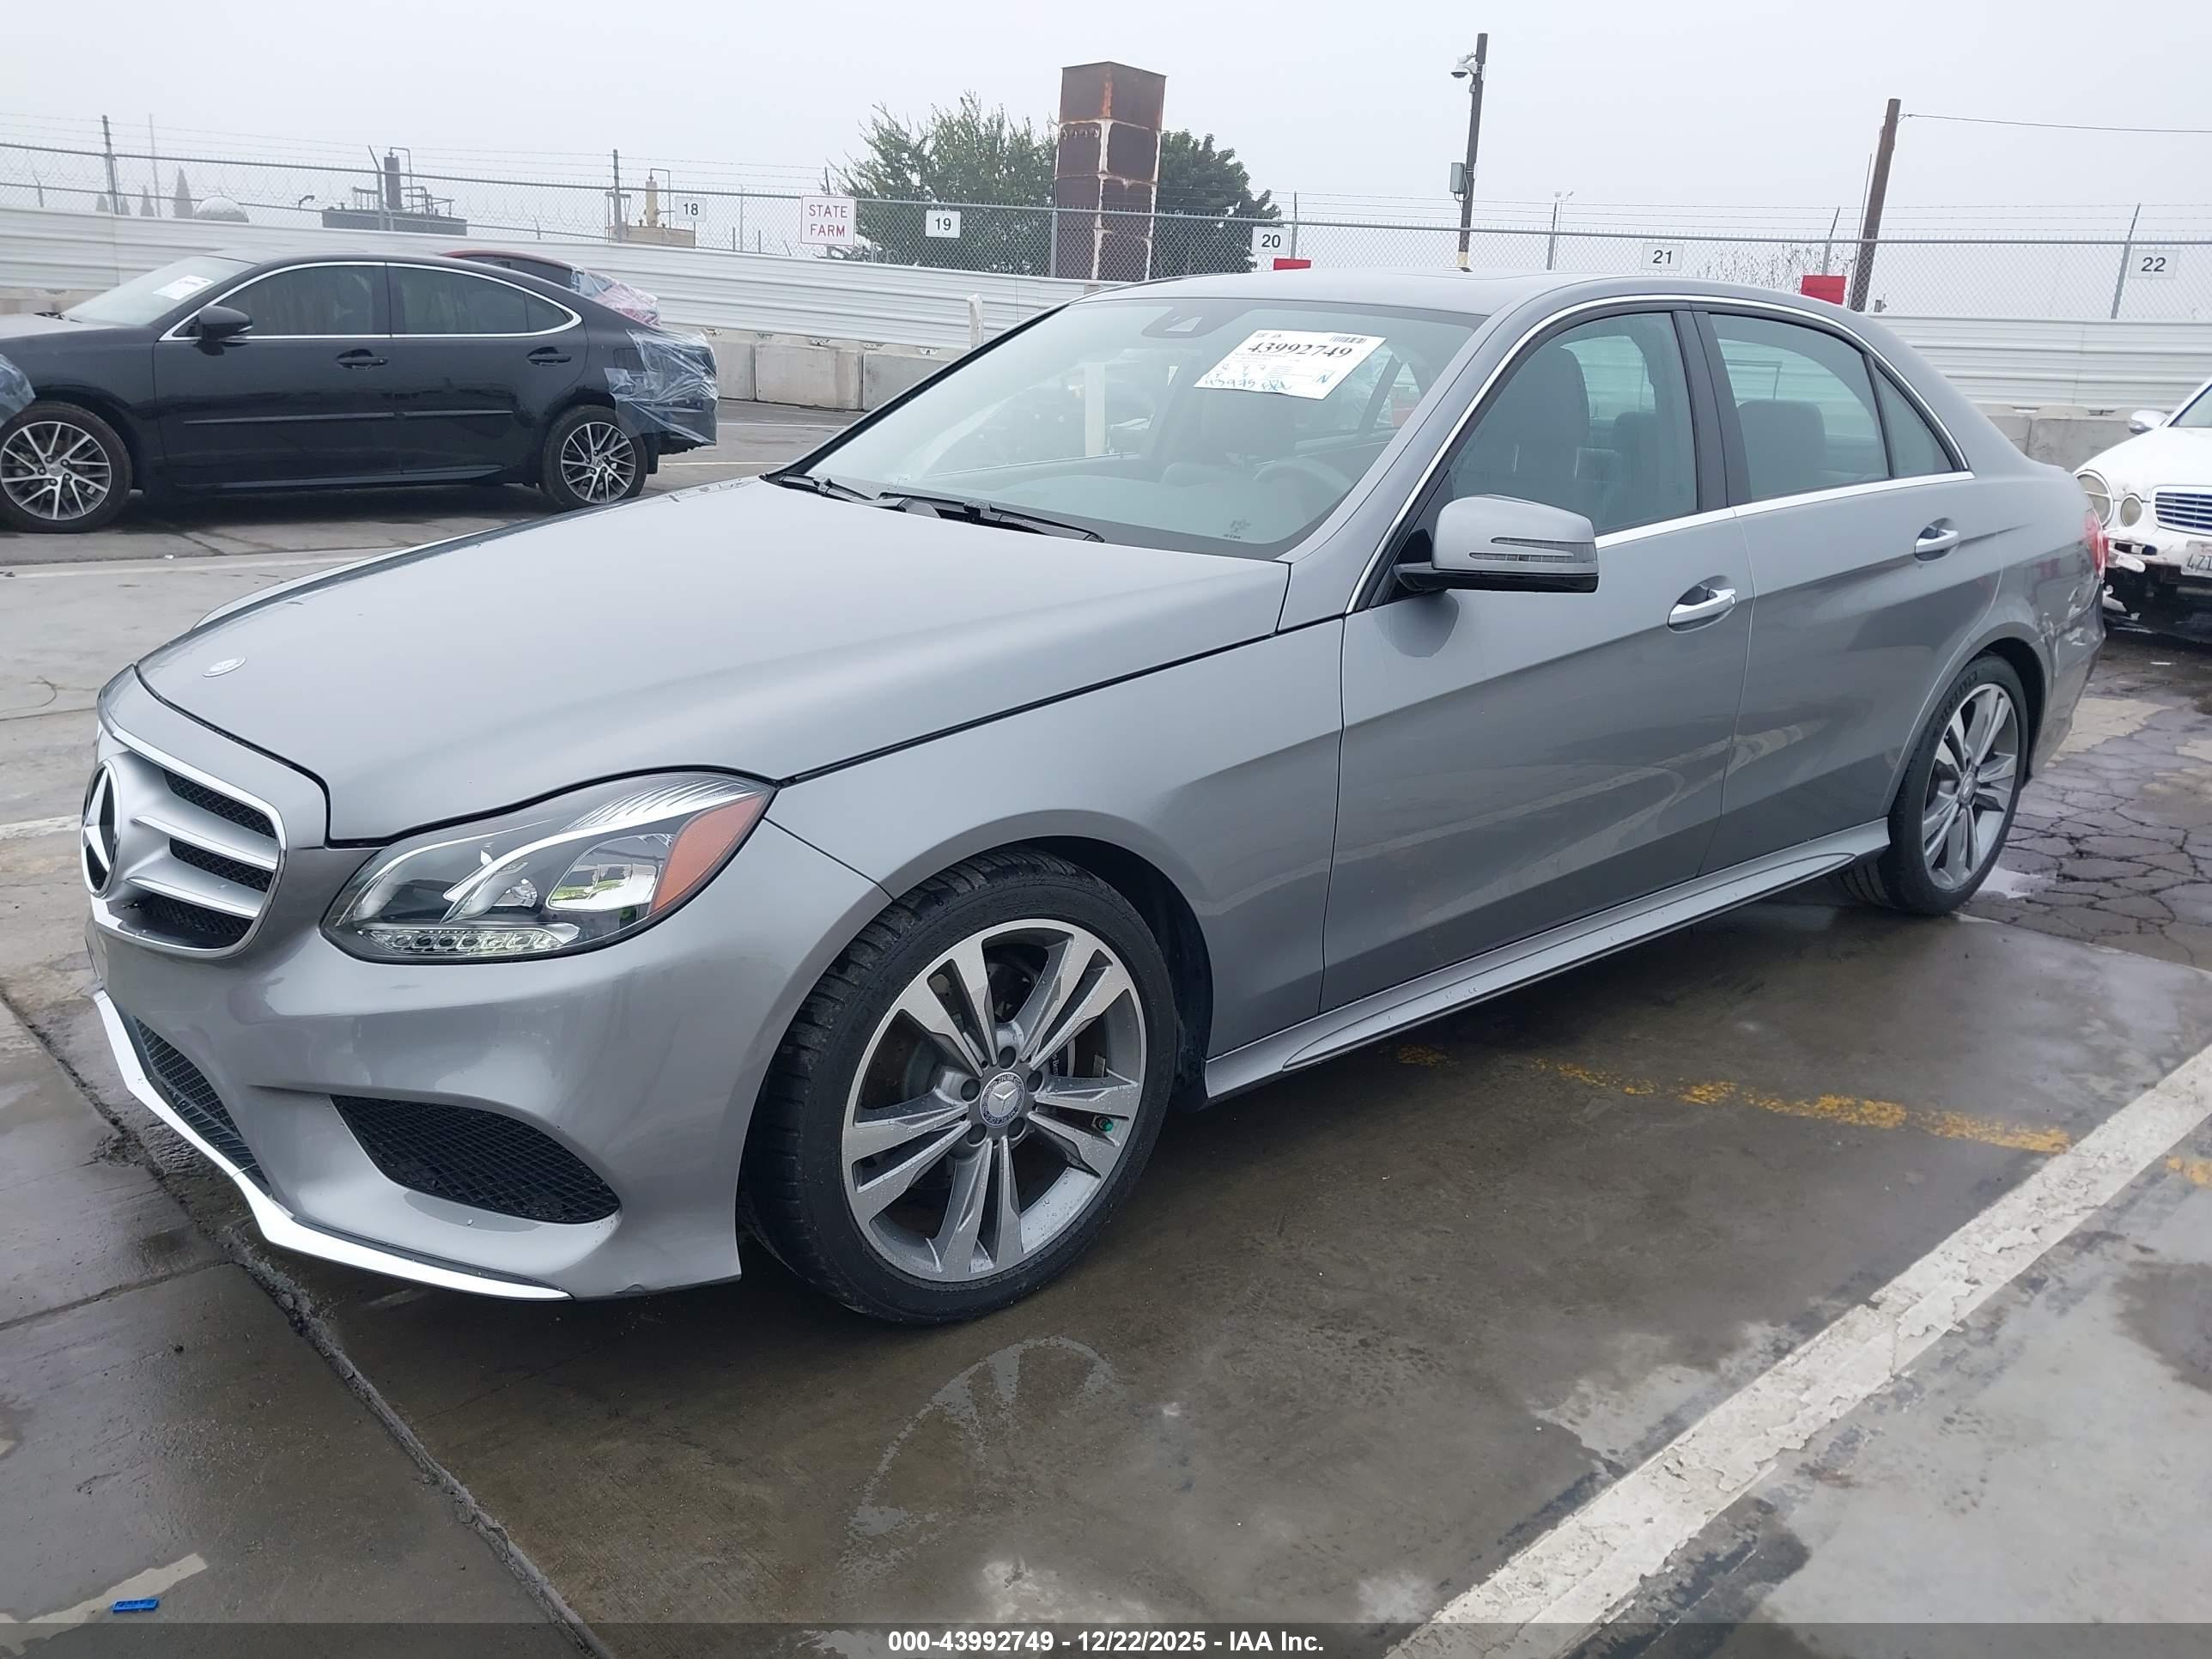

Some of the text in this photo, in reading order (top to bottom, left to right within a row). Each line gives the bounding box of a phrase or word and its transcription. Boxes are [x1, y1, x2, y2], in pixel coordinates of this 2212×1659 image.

[683, 203, 699, 216] 18
[808, 204, 848, 219] STATE
[810, 223, 846, 238] FARM
[934, 217, 951, 231] 19
[1261, 234, 1281, 248] 20
[1652, 249, 1673, 264] 21
[2141, 257, 2166, 272] 22
[1247, 342, 1353, 358] 43992749
